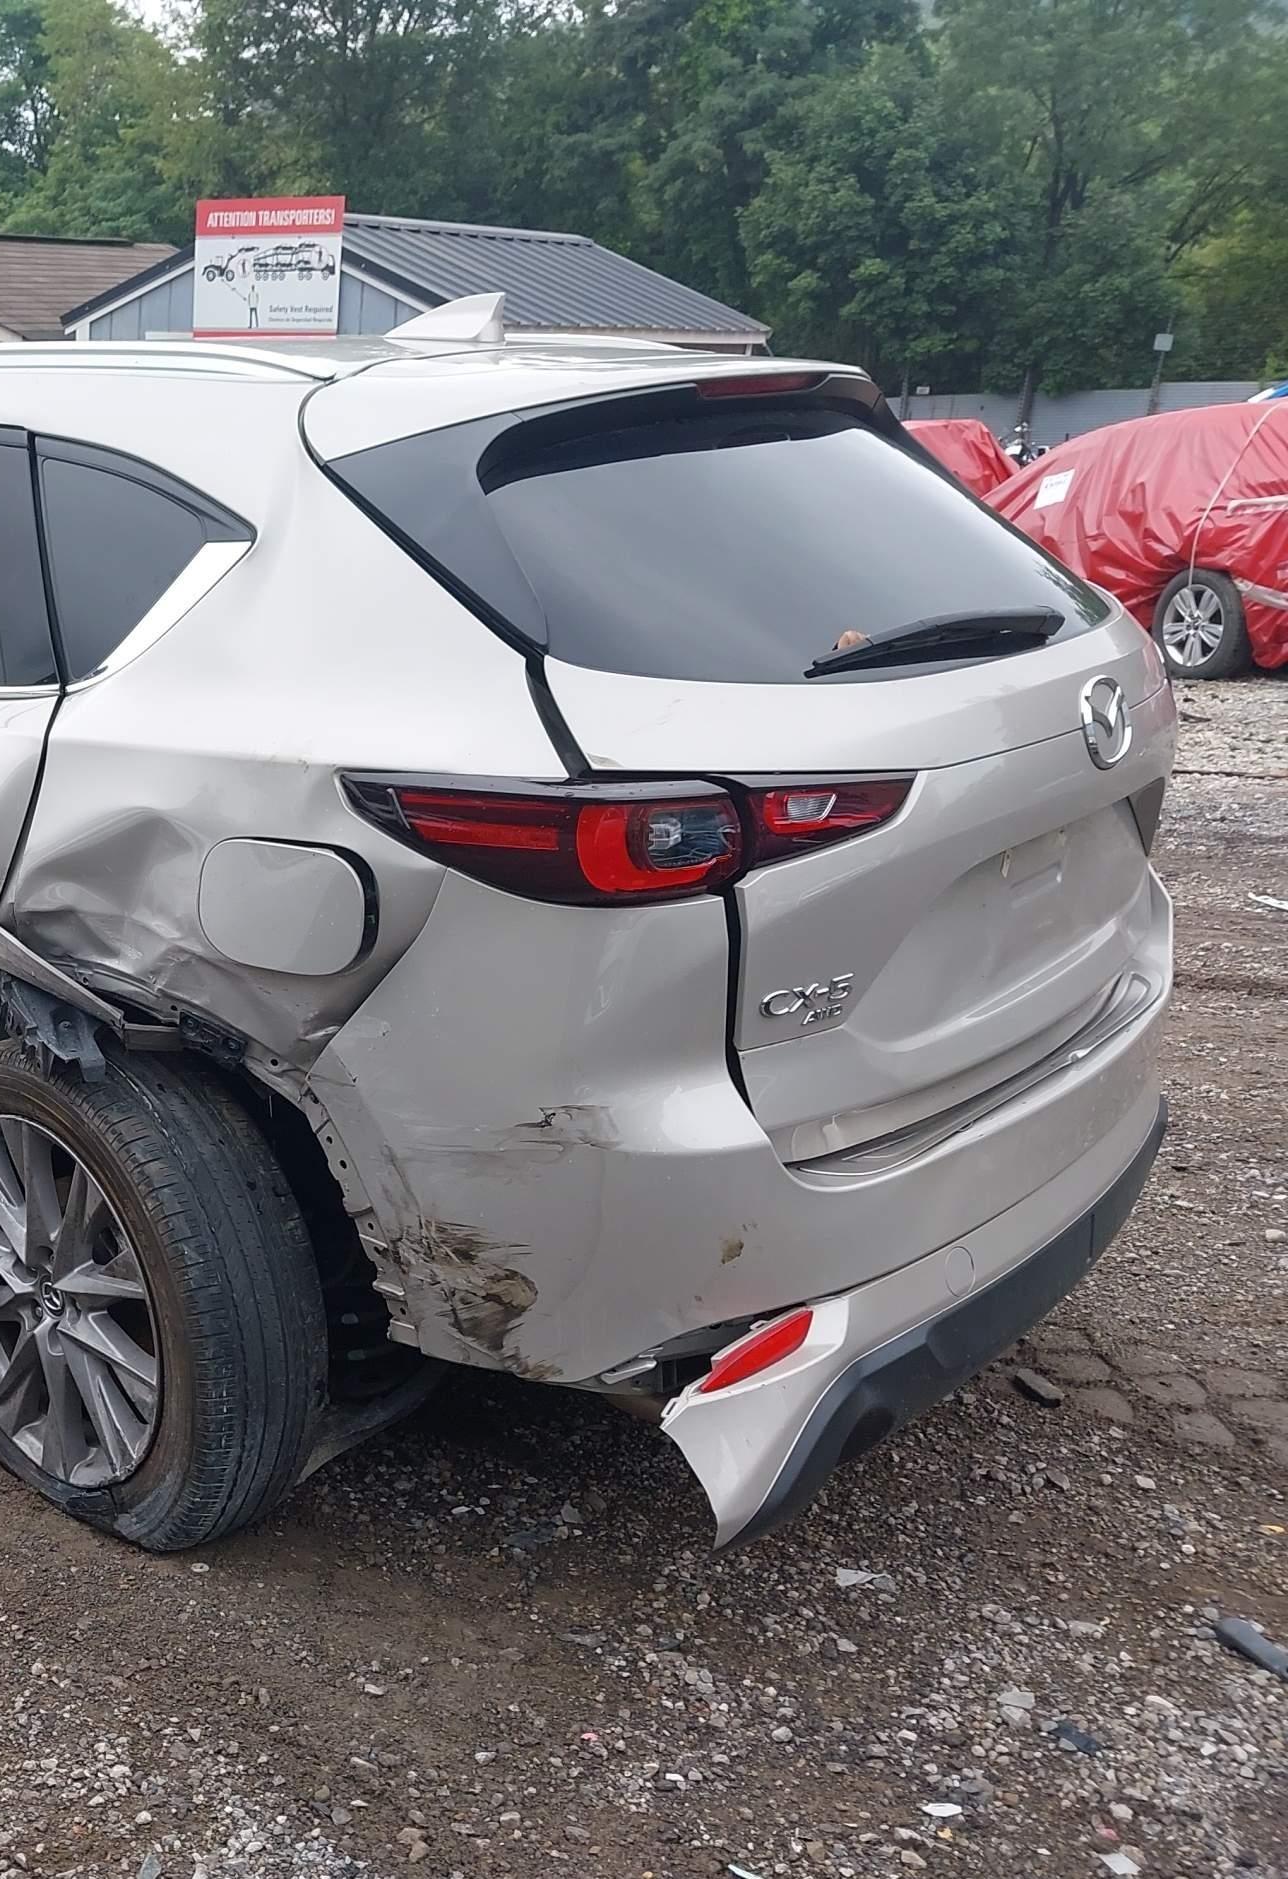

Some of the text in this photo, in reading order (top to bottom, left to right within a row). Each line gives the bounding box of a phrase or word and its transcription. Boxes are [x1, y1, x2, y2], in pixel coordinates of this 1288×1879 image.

[206, 208, 335, 228] ATTENTION TRANSPORTERS!
[269, 304, 288, 314] Safety
[304, 304, 334, 314] Required
[759, 972, 855, 1018] CX-5
